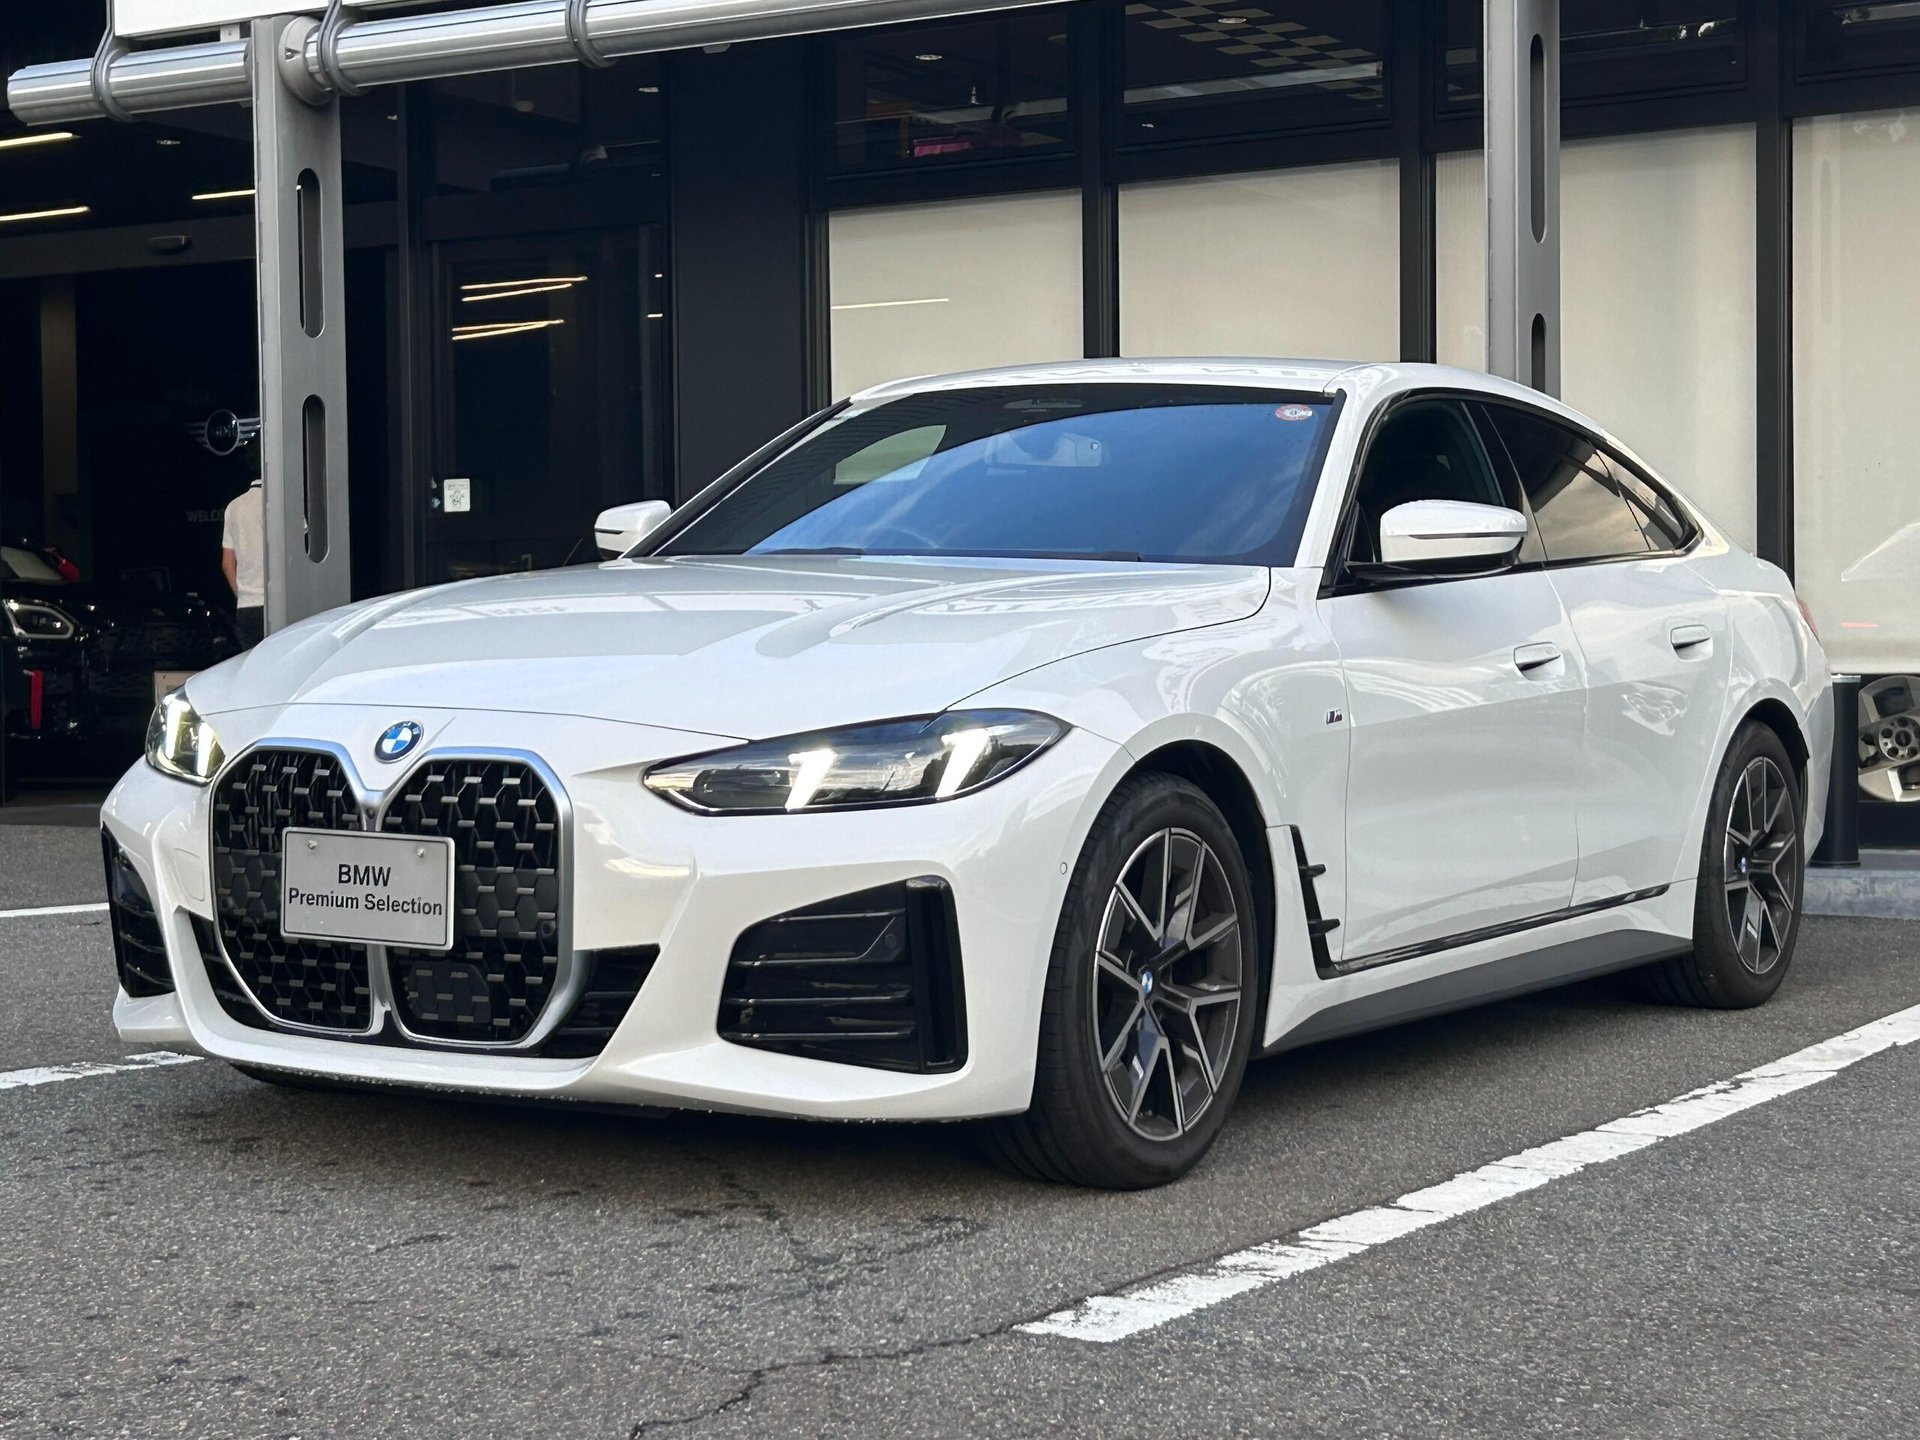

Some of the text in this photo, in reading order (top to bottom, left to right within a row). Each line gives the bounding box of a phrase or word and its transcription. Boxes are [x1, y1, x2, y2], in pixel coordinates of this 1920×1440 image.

[338, 864, 391, 886] BMW
[288, 887, 442, 916] Premium Selection
